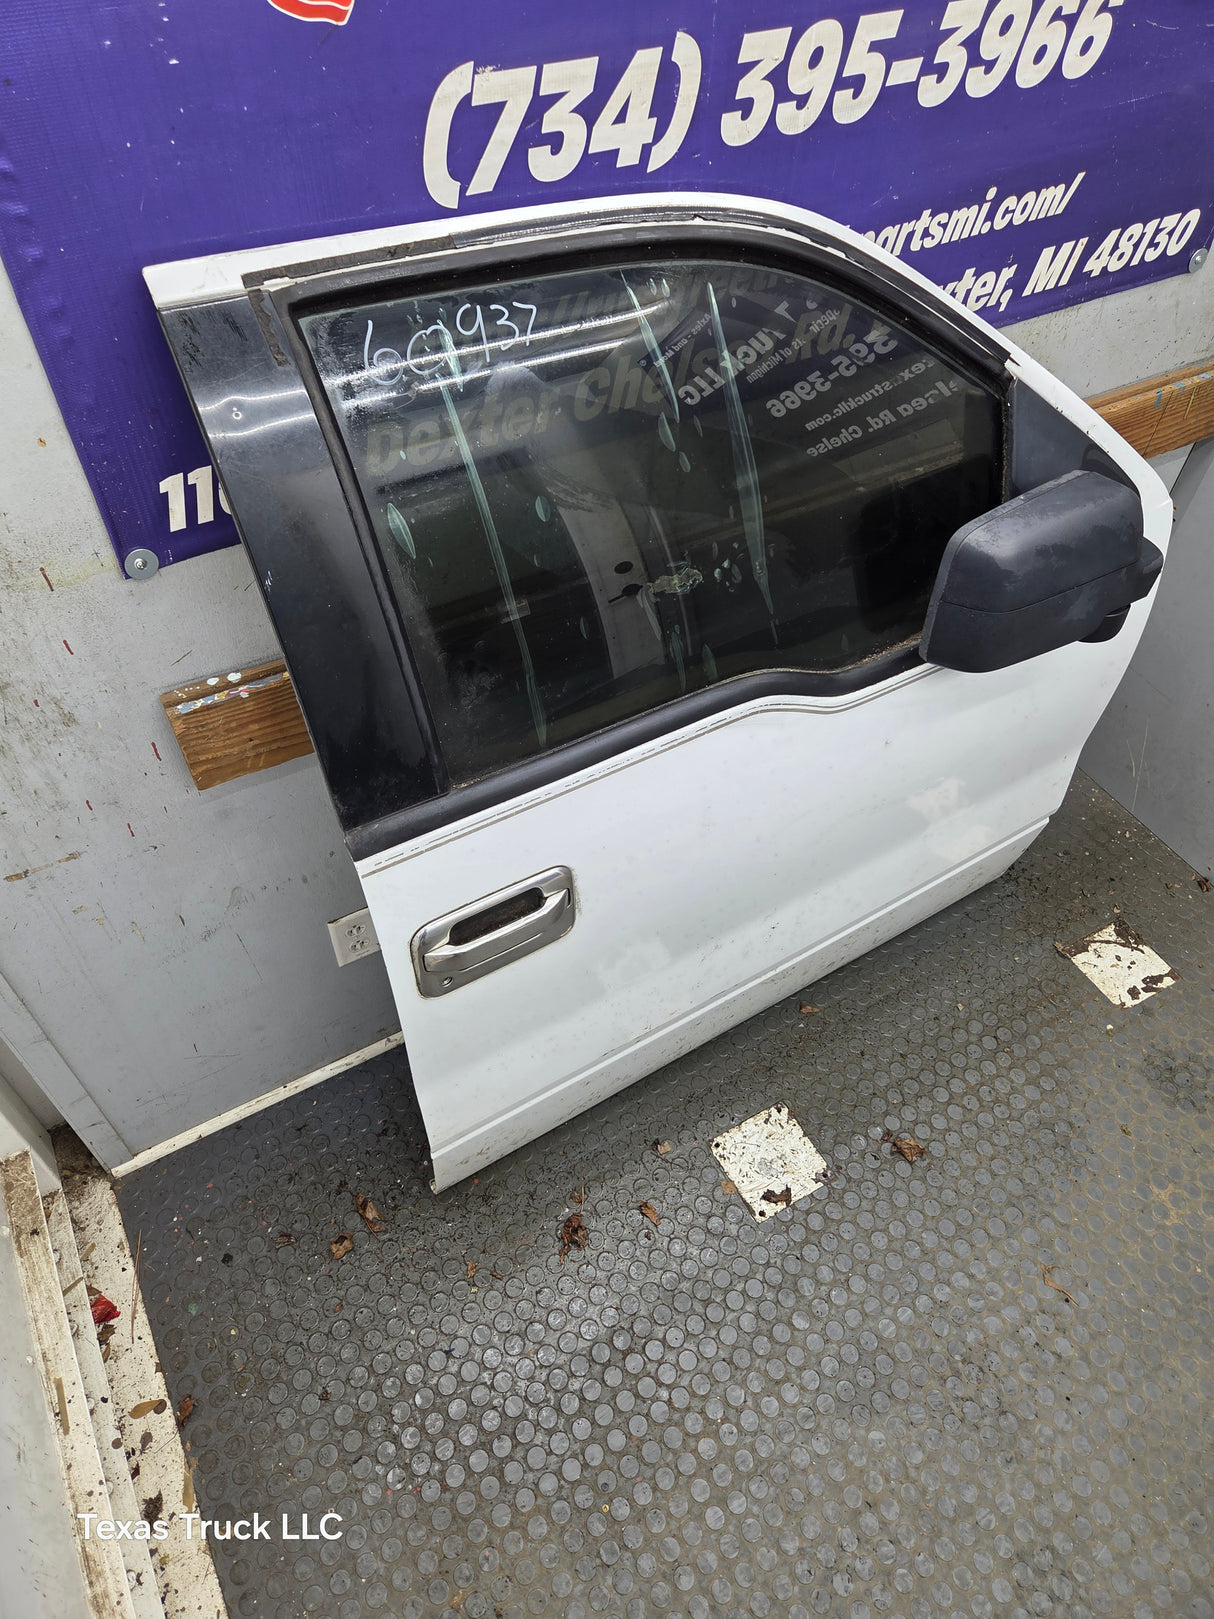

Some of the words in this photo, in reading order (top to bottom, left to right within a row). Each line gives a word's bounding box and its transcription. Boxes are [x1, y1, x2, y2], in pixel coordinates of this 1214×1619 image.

[423, 31, 702, 209] (734)
[720, 0, 1124, 147] 395-3966
[159, 465, 233, 533] 11
[1022, 236, 1089, 297] MI
[1082, 208, 1201, 278] 48130
